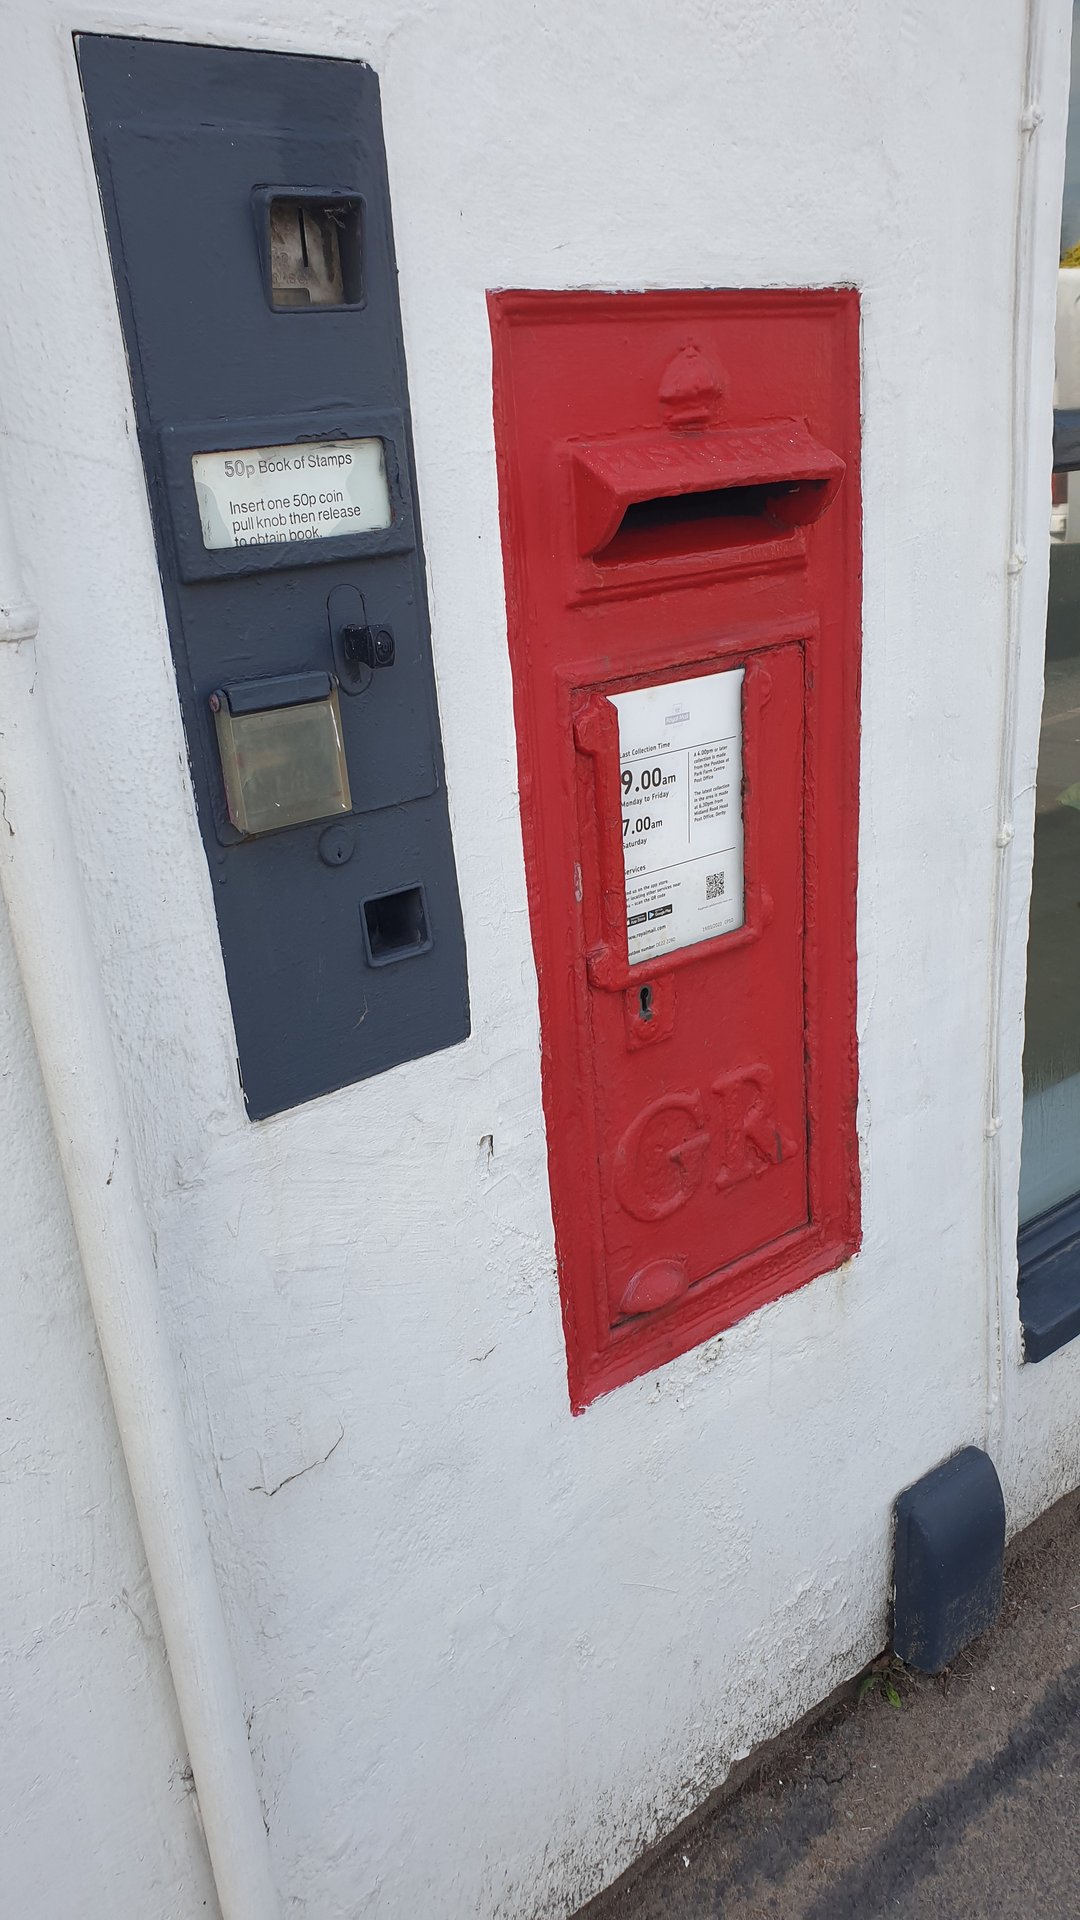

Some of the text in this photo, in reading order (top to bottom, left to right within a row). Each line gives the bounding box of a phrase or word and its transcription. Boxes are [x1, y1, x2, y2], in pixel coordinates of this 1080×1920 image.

[225, 454, 352, 478] 50p Book of Stamps
[230, 490, 344, 514] Insert one 50p coin
[232, 506, 361, 534] pull knob then release
[234, 526, 322, 547] to obtain book.
[632, 745, 656, 755] Collection
[621, 767, 676, 795] 9.00am
[652, 791, 669, 800] Friday
[622, 816, 662, 836] 7.00am
[625, 865, 646, 875] ervices
[612, 1062, 798, 1223] GR
